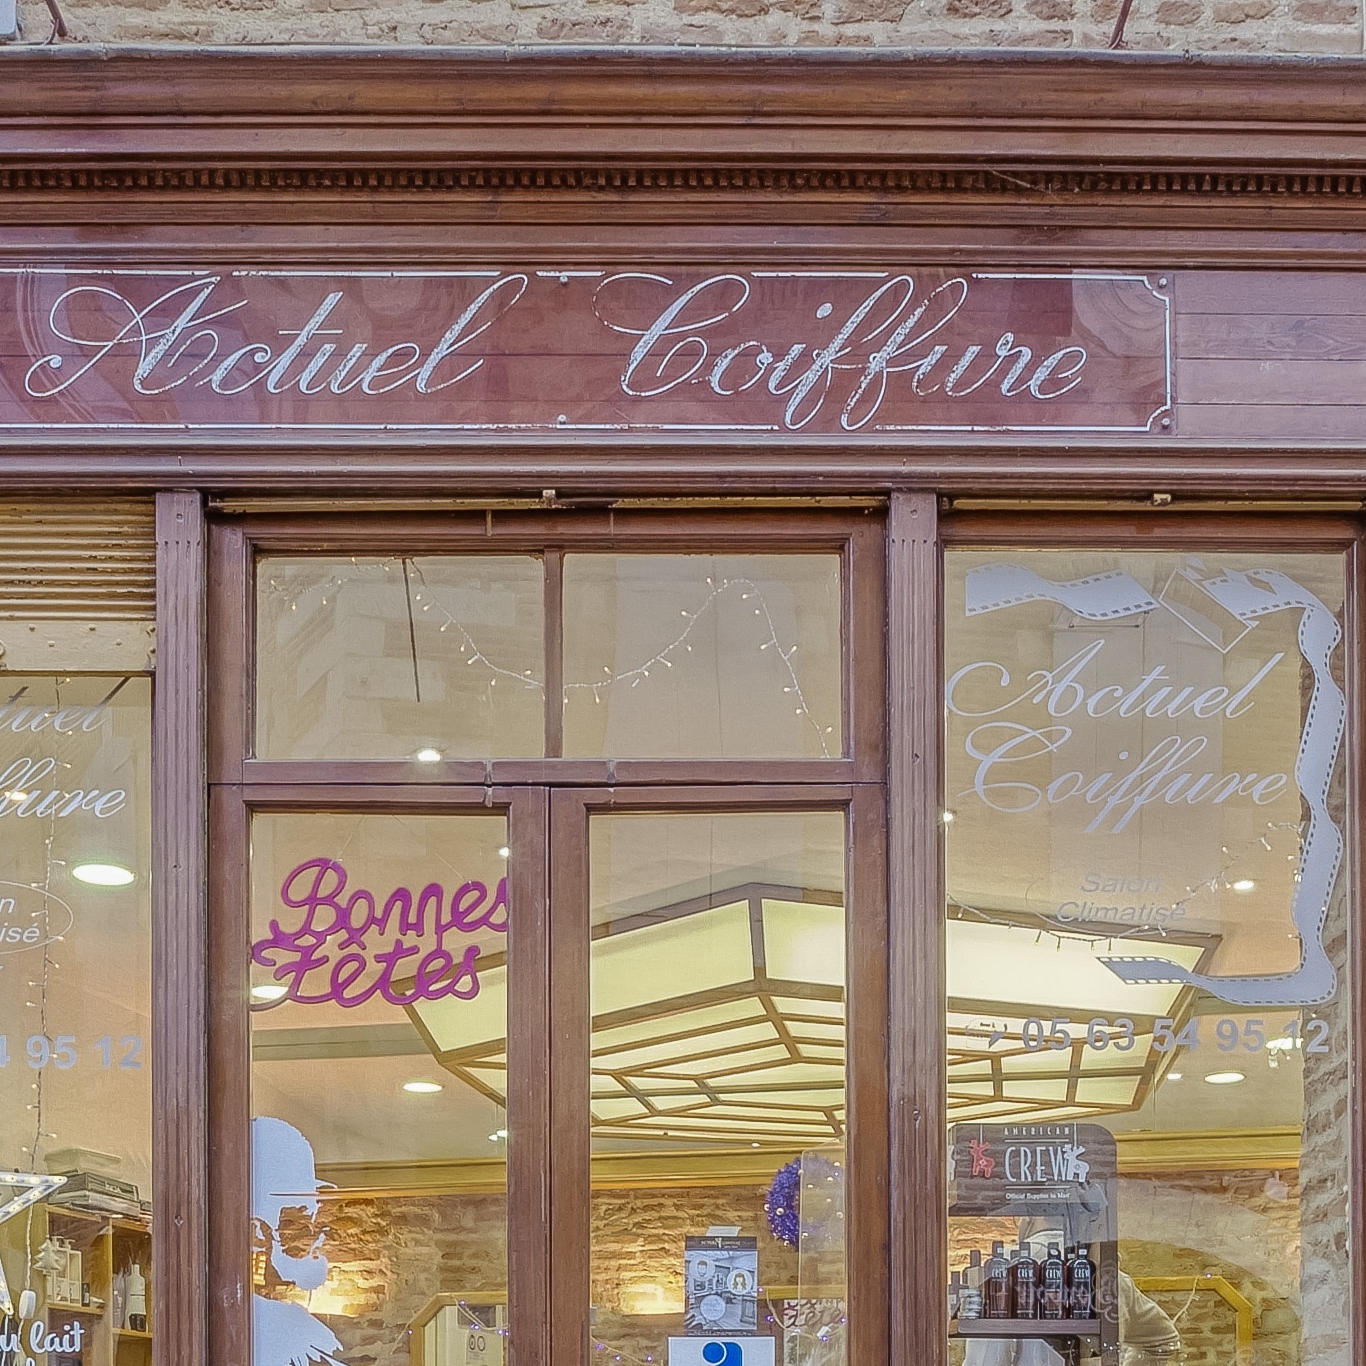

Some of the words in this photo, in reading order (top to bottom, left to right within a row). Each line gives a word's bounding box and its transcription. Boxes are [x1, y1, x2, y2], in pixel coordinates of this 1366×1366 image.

[25, 273, 530, 400] Actuel
[593, 273, 1088, 431] Coiffure
[946, 640, 1285, 719] Actuel
[957, 721, 1287, 833] Coiffure
[269, 858, 508, 941] Bonnes
[1081, 872, 1164, 894] Salon
[1056, 898, 1188, 923] Climatisé
[251, 931, 481, 1008] Fêtes
[26, 1034, 77, 1069] 95
[94, 1035, 144, 1069] 12
[1022, 1018, 1071, 1051] 05
[1086, 1018, 1135, 1051] 63
[1152, 1018, 1199, 1052] 54
[1216, 1019, 1265, 1053] 95
[1003, 1126, 1070, 1136] AMERICAN
[1004, 1146, 1068, 1182] CREW
[29, 1320, 86, 1354] lait
